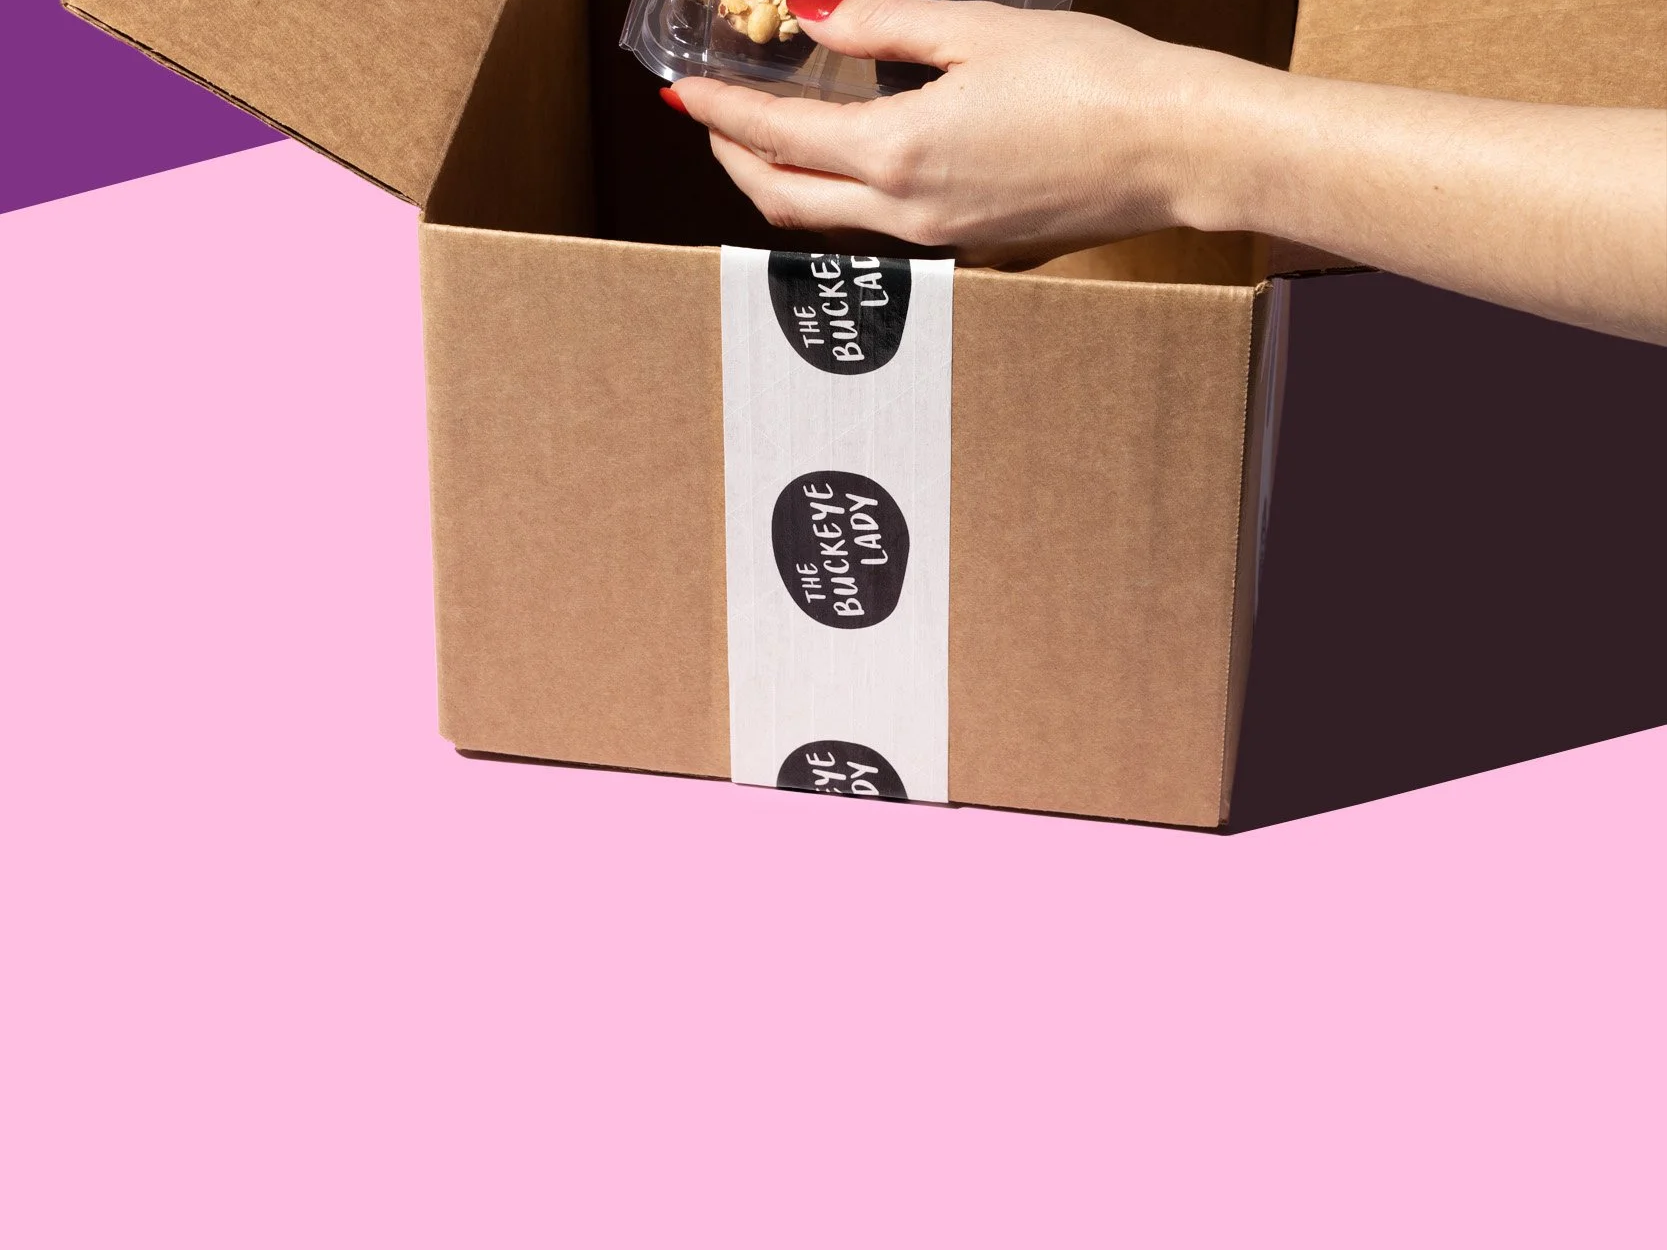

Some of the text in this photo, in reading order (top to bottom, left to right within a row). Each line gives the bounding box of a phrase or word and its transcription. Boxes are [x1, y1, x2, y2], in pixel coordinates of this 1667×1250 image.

[793, 305, 825, 348] THE
[803, 483, 865, 616] BUCKEYE
[845, 493, 888, 565] LADY
[796, 563, 826, 603] THE
[805, 751, 847, 794] YE
